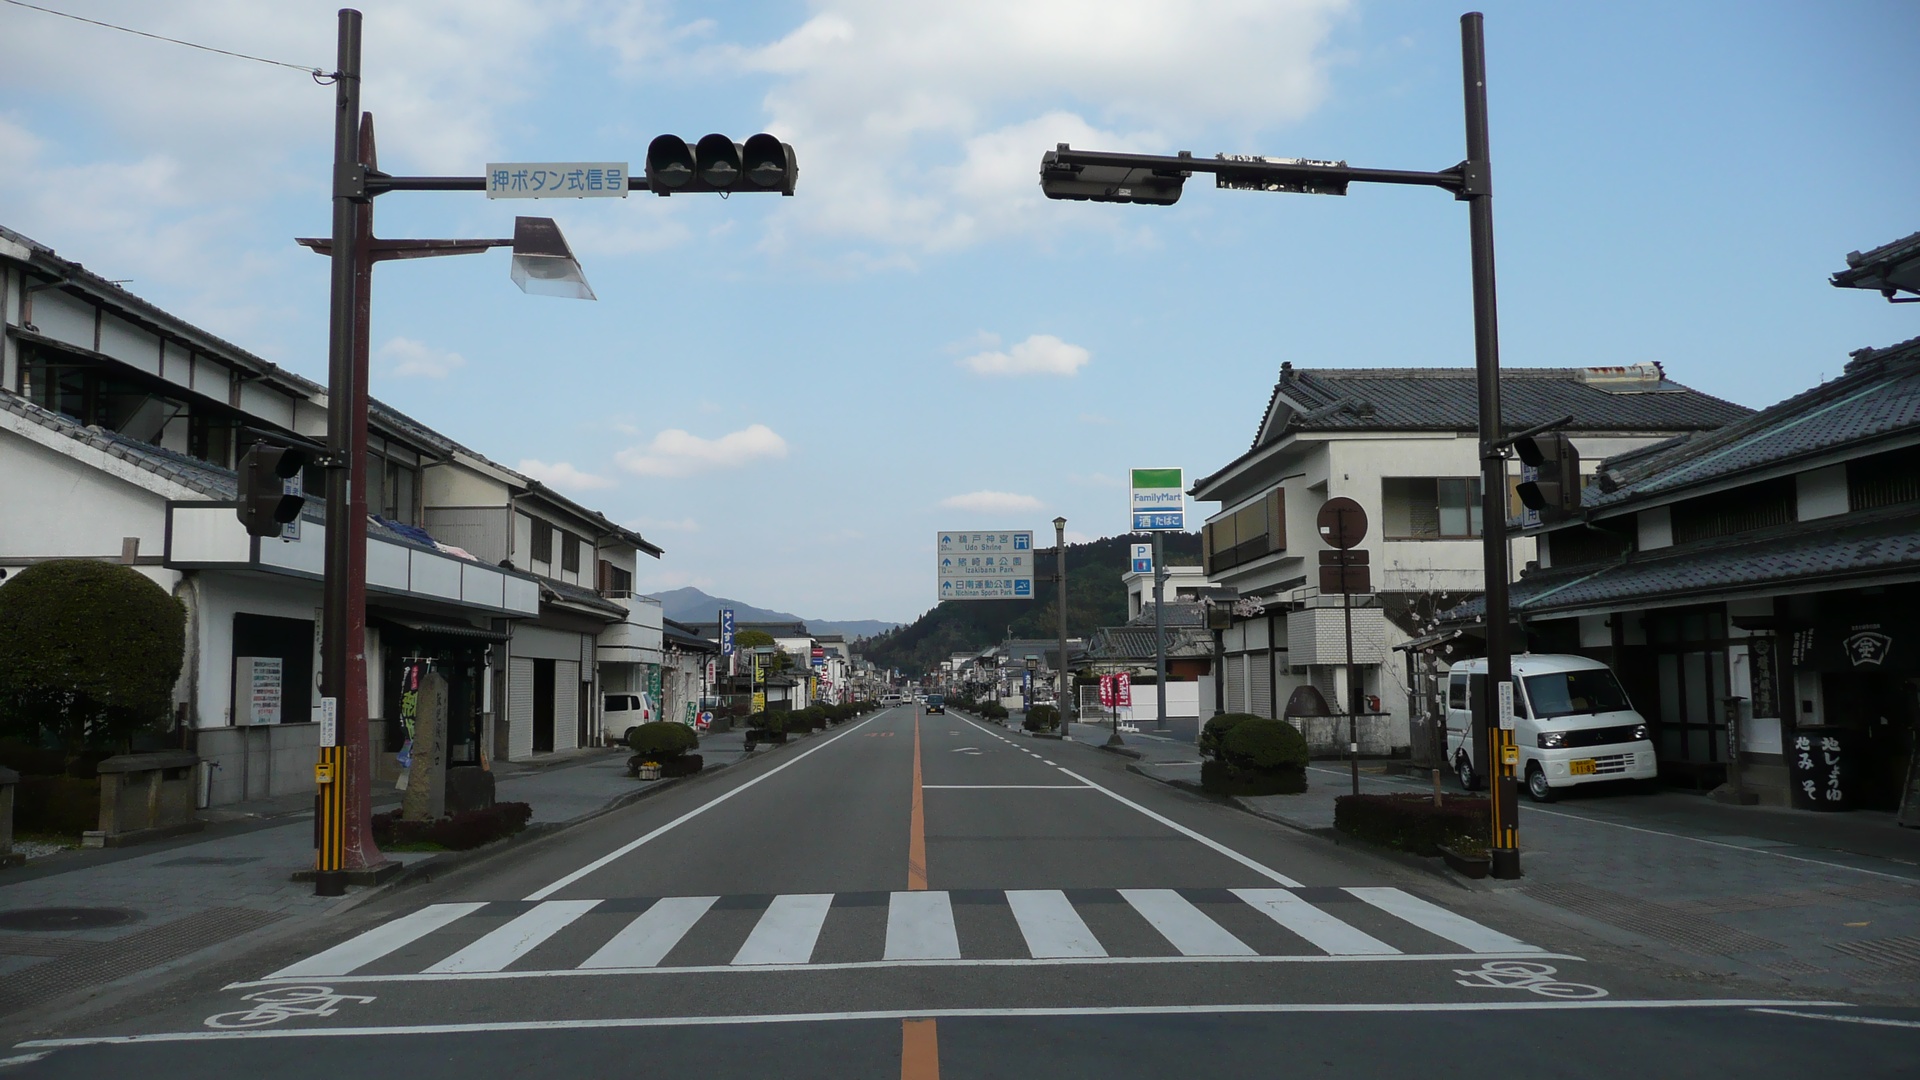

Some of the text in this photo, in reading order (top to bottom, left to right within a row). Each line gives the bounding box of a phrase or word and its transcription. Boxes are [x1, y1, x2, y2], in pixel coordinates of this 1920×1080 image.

[491, 169, 623, 192] 押ボタン式信号
[1134, 493, 1182, 503] FamilyMart
[1139, 515, 1180, 527] 酒 たばこ
[1137, 546, 1146, 557] P
[955, 580, 1012, 590] 日南運動公園
[724, 621, 733, 653] くすり
[1794, 736, 1817, 800] 地みそ
[1820, 736, 1843, 801] 地しょうゆ
